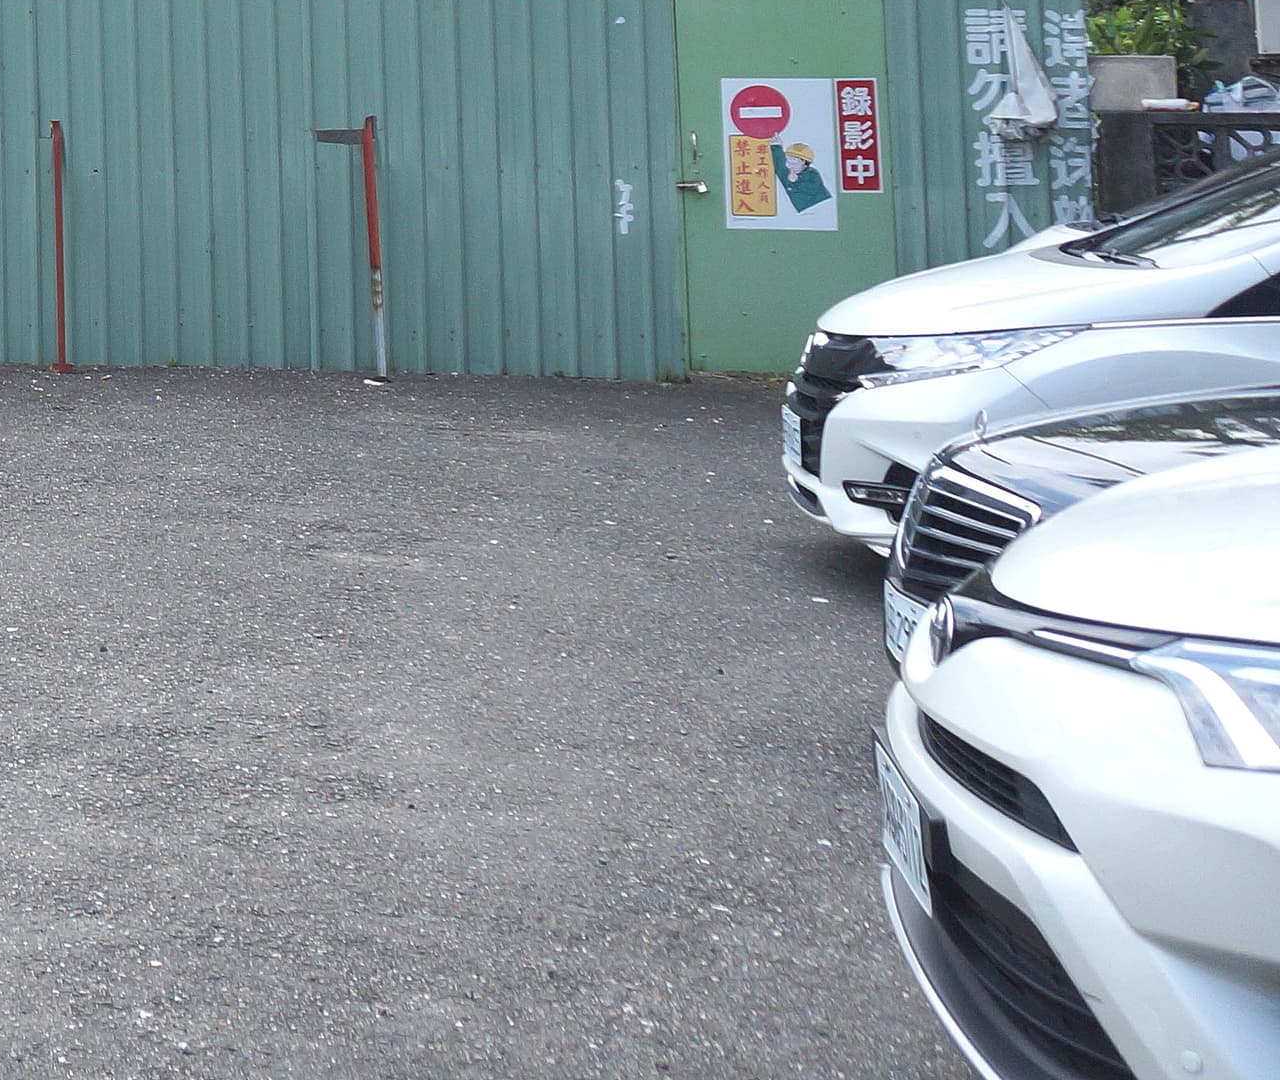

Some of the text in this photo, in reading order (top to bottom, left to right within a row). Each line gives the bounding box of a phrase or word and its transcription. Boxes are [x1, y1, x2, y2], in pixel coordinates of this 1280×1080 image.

[734, 139, 755, 213] 禁止進入
[840, 86, 876, 185] 錄影中
